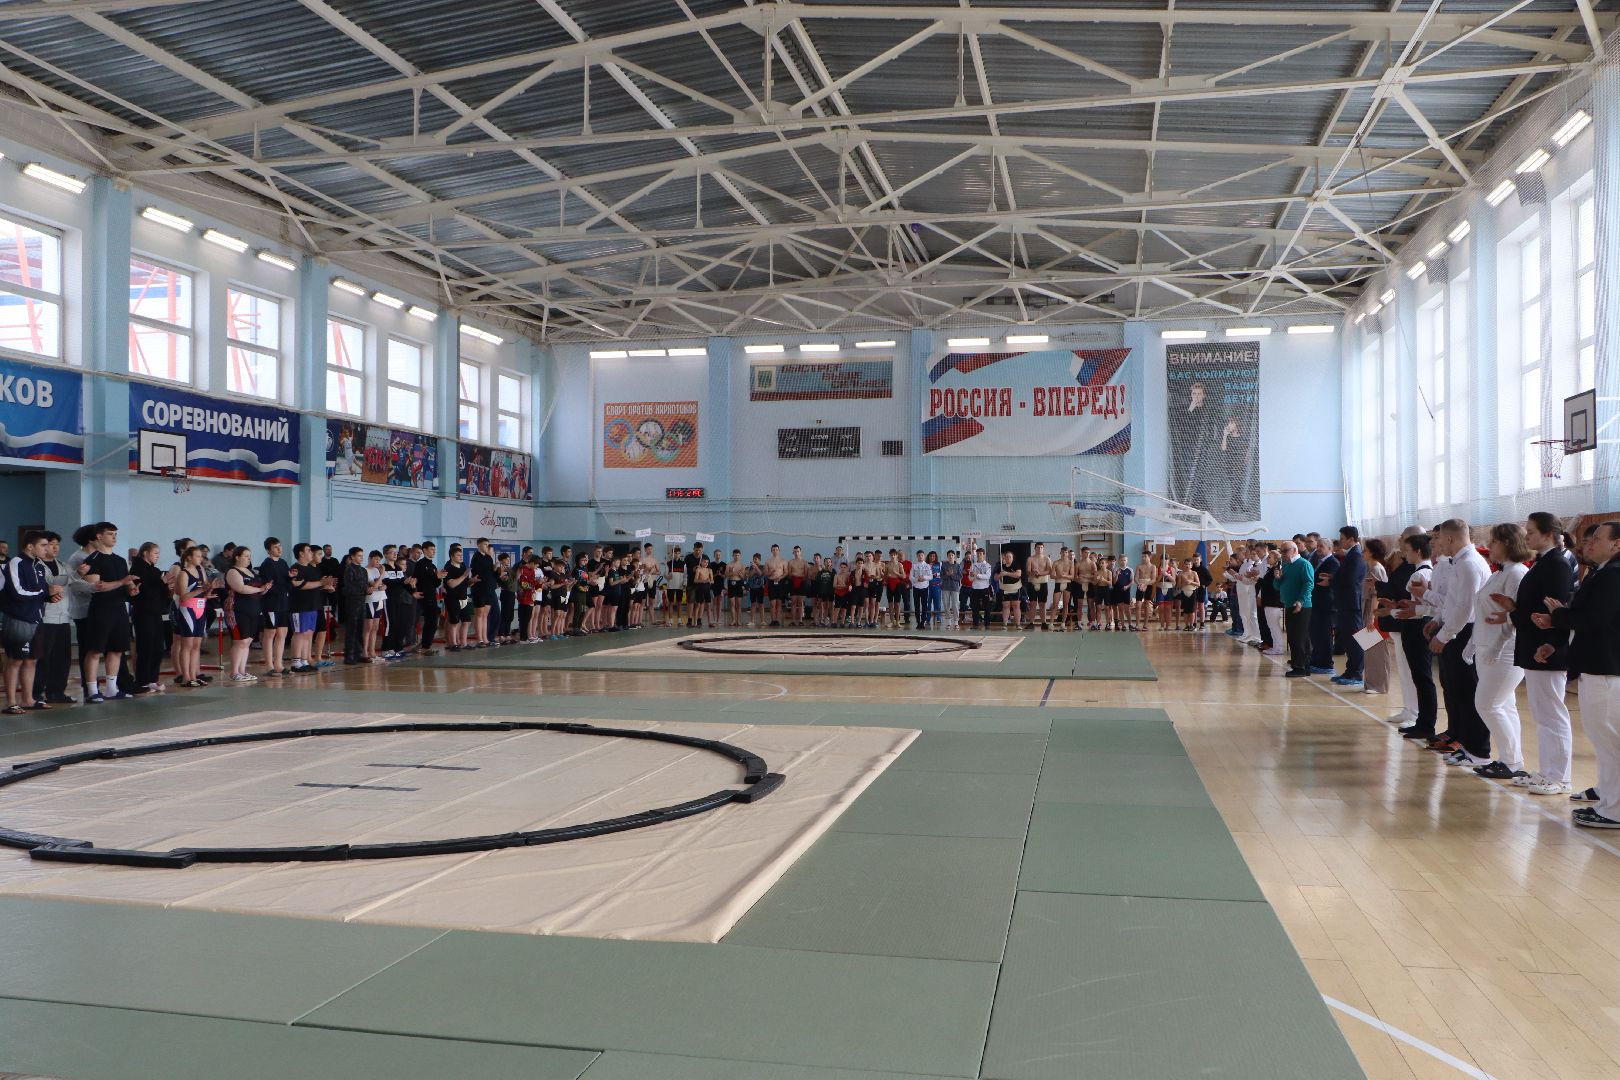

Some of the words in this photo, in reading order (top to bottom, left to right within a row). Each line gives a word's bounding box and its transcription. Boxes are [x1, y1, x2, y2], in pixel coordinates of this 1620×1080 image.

[1169, 350, 1258, 364] ВНИМАНИЕ!
[0, 374, 54, 408] КОВ
[929, 387, 1012, 417] РОССИЯ
[1033, 384, 1126, 420] ВПЕРЕД!
[141, 399, 290, 444] СОРЕВНОВАНИЙ
